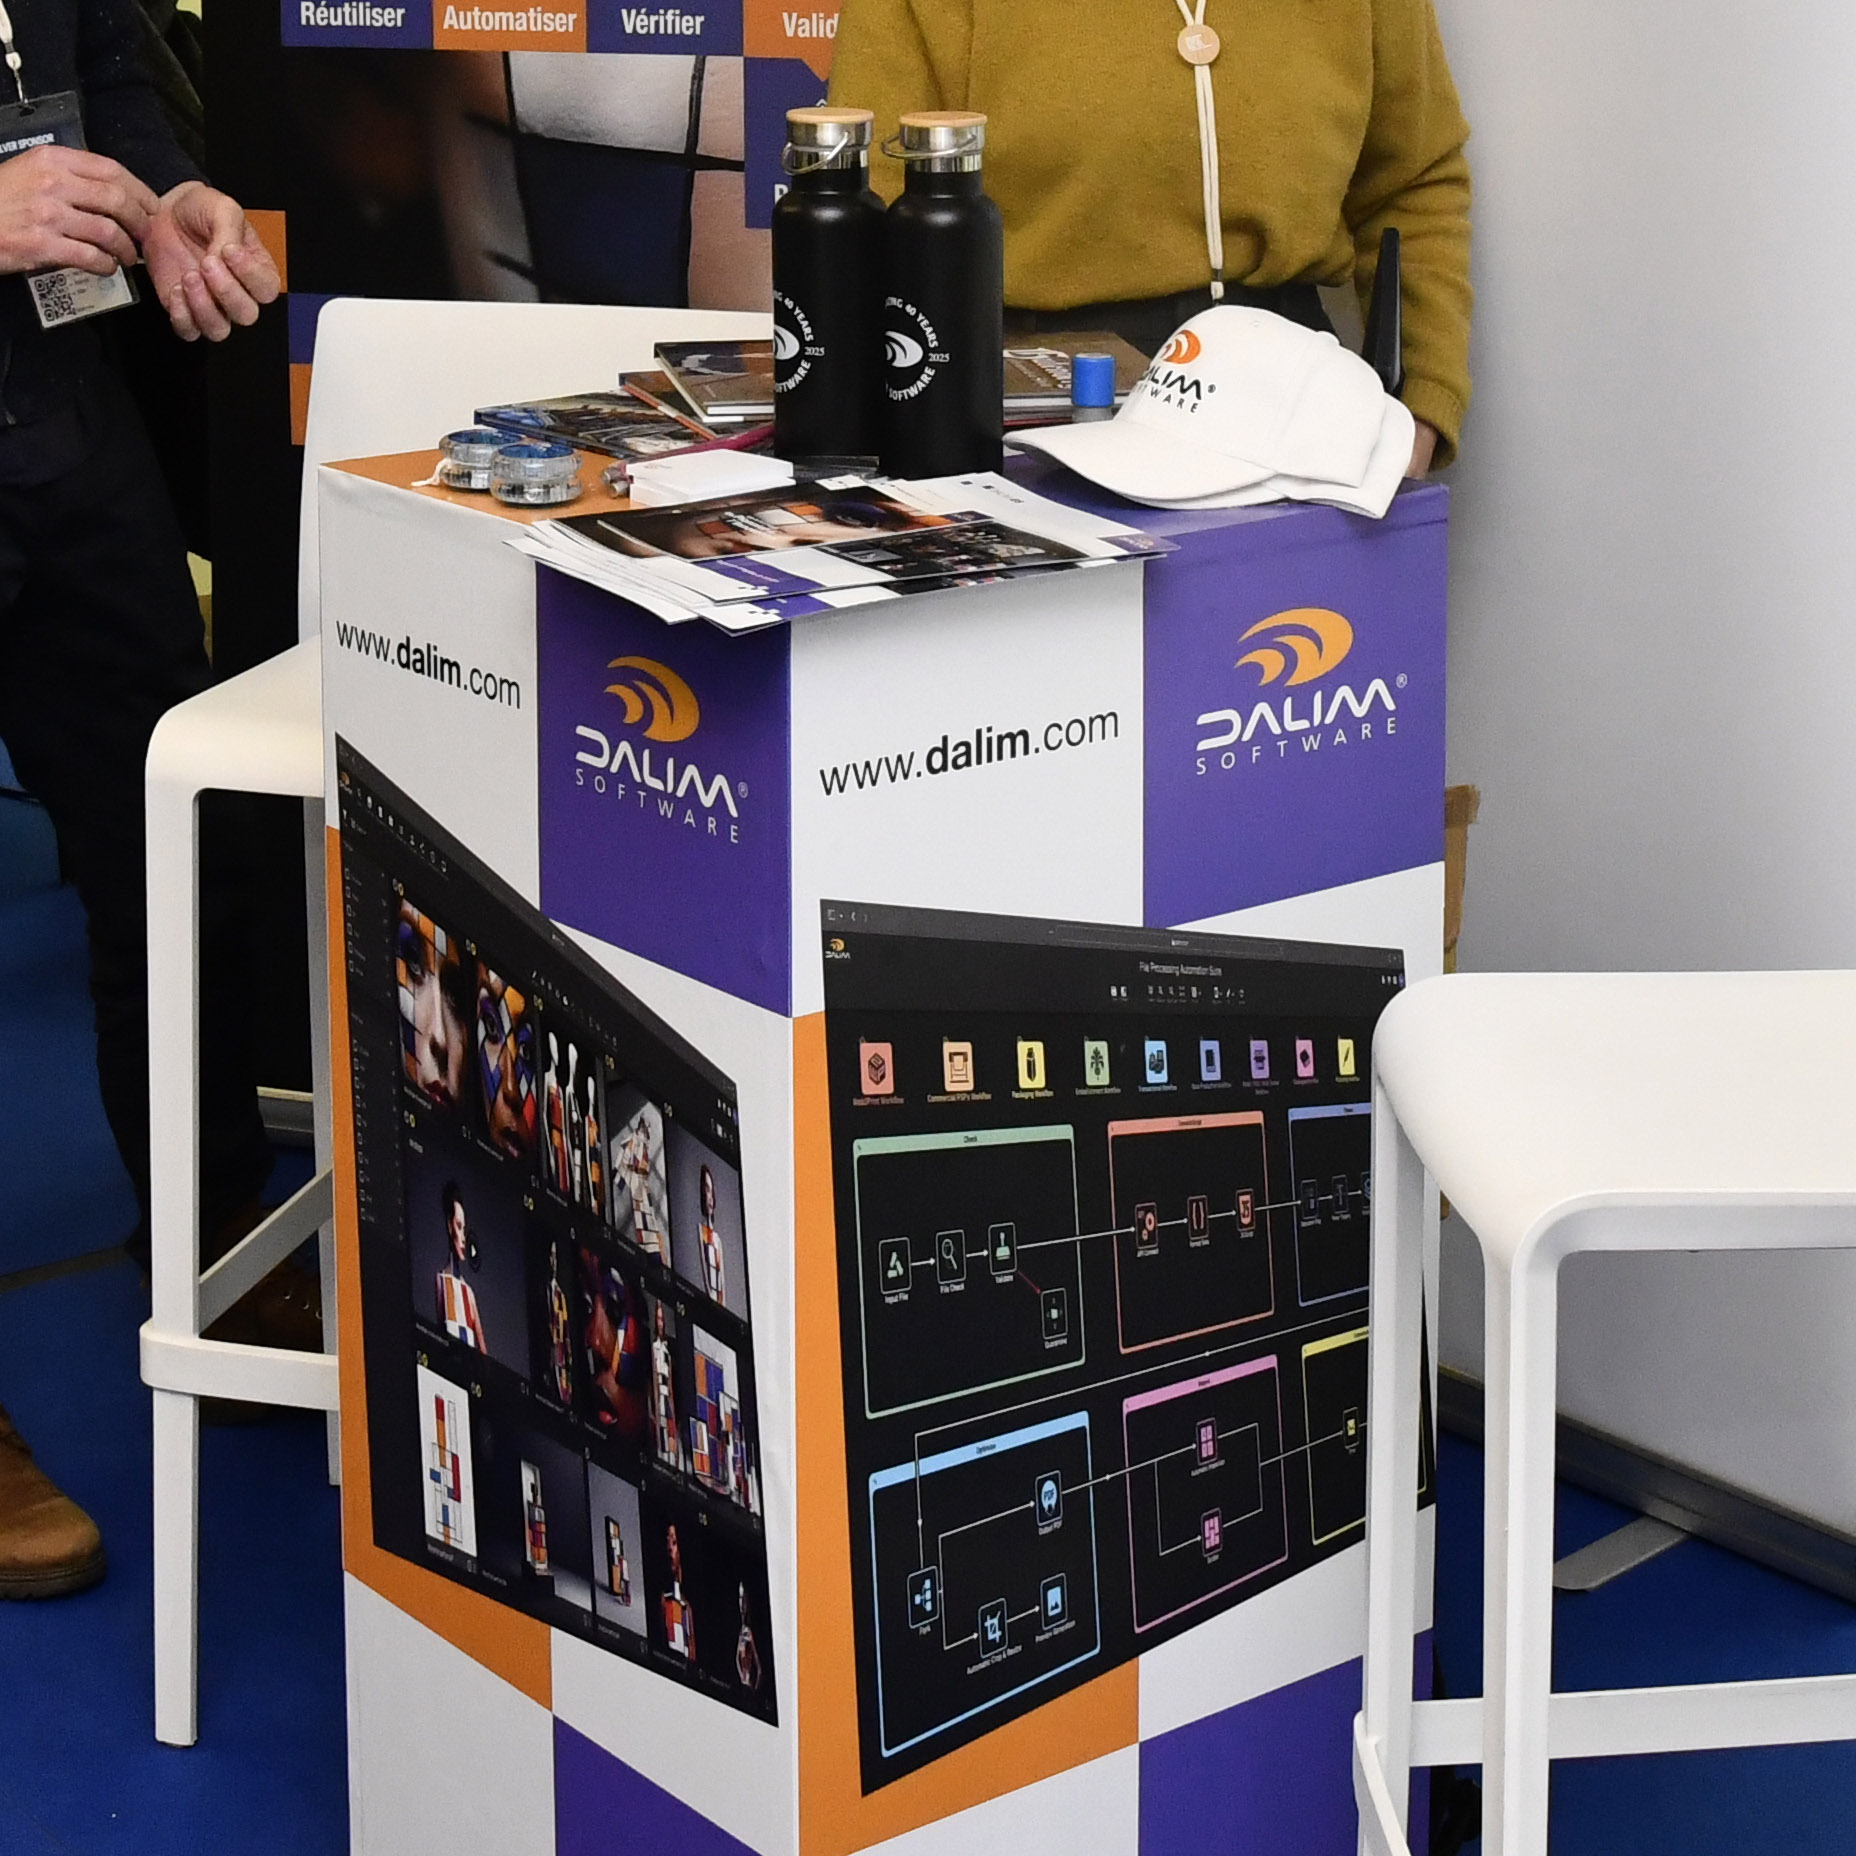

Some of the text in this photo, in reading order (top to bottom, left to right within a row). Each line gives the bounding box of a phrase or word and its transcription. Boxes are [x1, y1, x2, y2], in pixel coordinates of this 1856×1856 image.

[300, 1, 405, 29] Réutiliser
[443, 5, 577, 33] Automatiser
[621, 8, 705, 36] Vérifier
[782, 12, 840, 39] Valid
[17, 132, 56, 150] SPONSOR
[794, 305, 815, 343] YEARS
[916, 313, 939, 349] YEARS
[804, 345, 826, 357] 2025
[928, 352, 951, 363] 2025
[888, 365, 937, 402] SOFTWARE
[336, 620, 520, 709] www.dalim.com
[1195, 678, 1397, 752] DALIM
[819, 711, 1119, 796] www.dalim.com
[1195, 717, 1397, 776] SOFTWARE
[575, 725, 739, 818] DALIM
[575, 768, 739, 844] SOFTWARE
